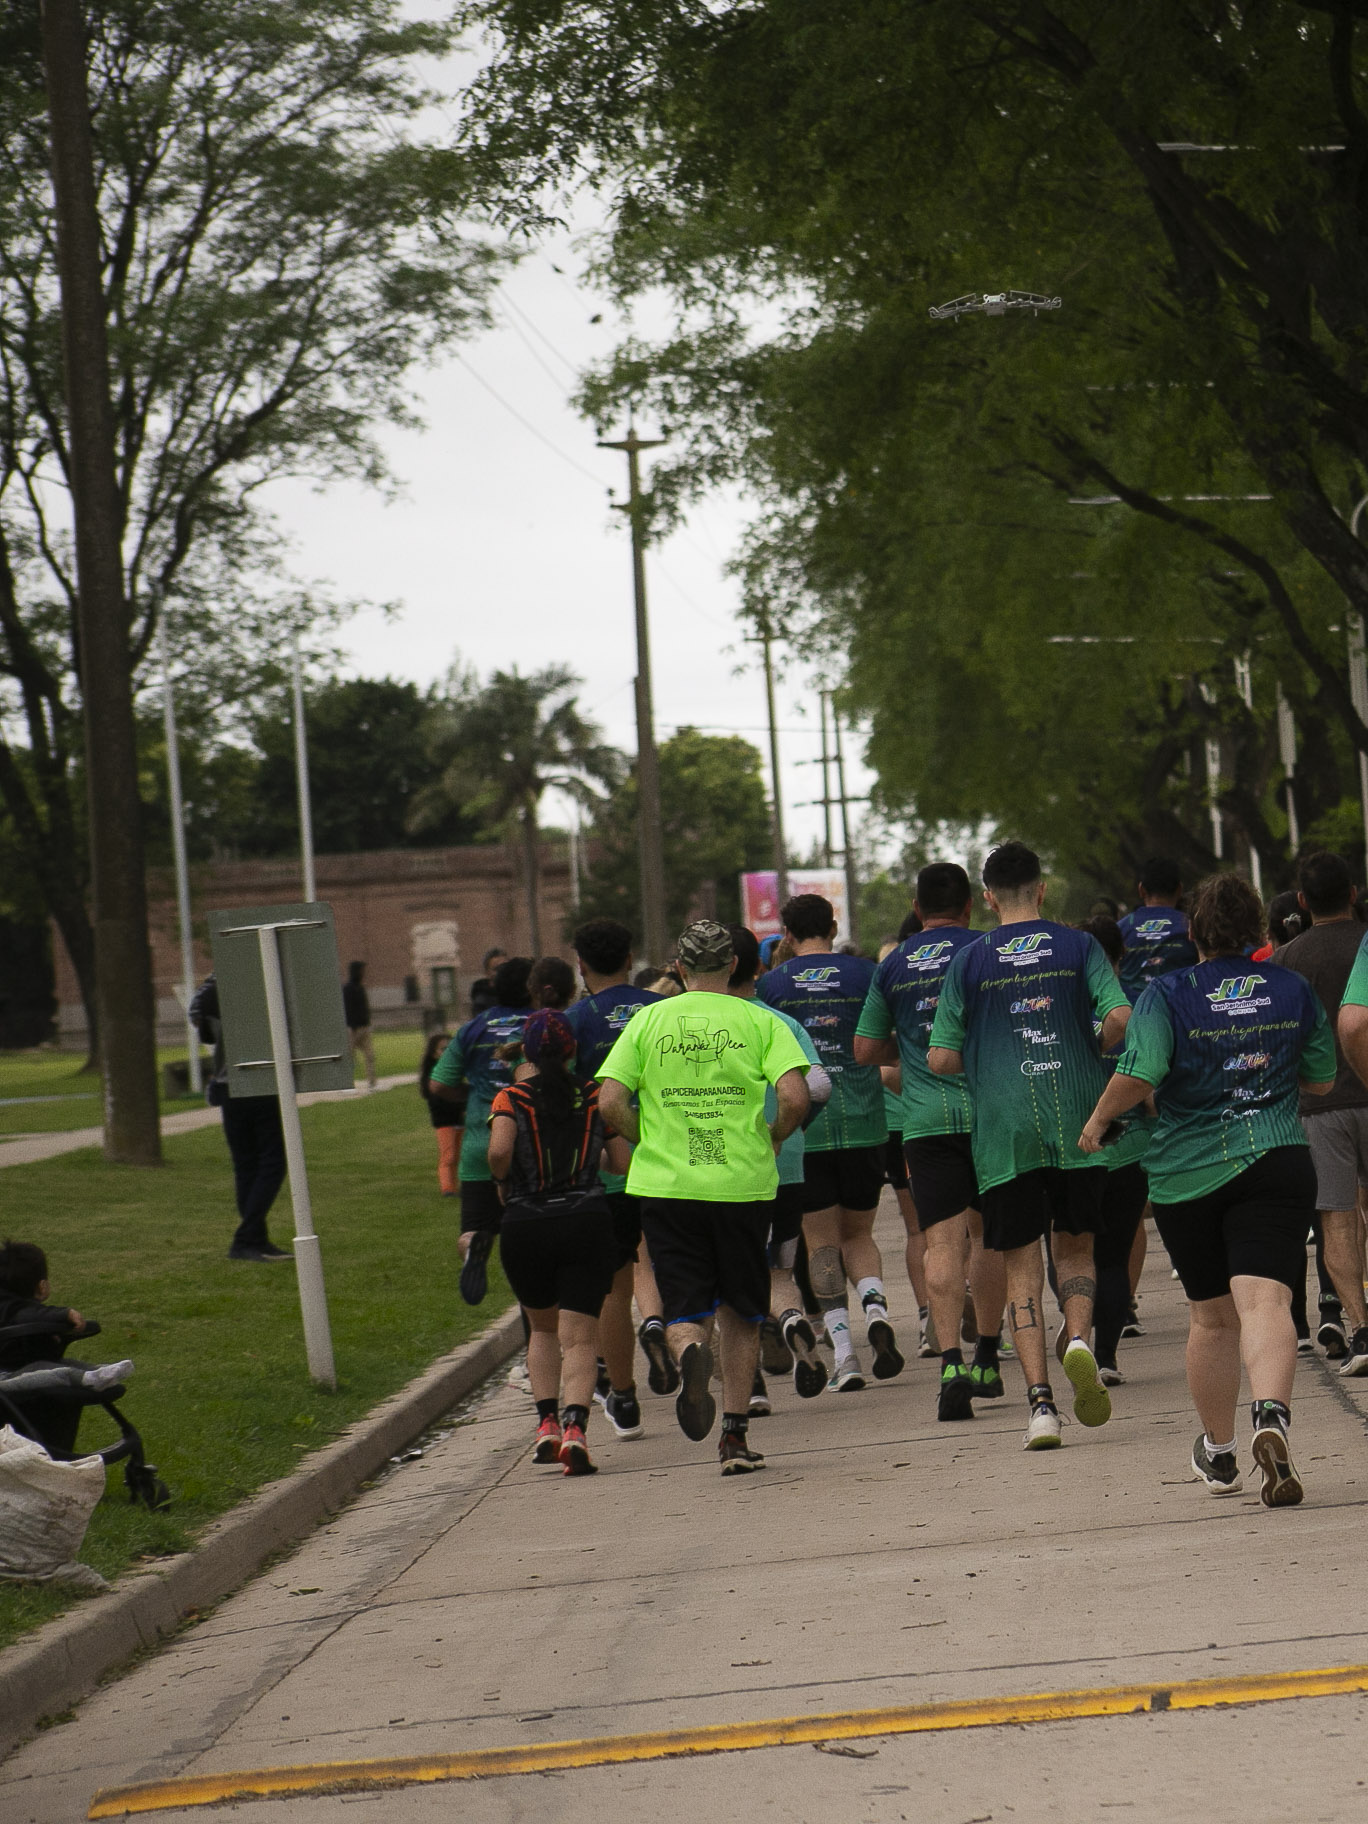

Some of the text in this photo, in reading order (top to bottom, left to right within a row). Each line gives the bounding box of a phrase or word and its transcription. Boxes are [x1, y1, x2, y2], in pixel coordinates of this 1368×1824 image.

[1211, 1003, 1225, 1011] San
[1257, 997, 1271, 1005] Sud
[1023, 1030, 1042, 1039] Max
[713, 1029, 747, 1055] Deco
[1032, 1036, 1050, 1044] Run
[1021, 1060, 1062, 1076] CRONO
[1232, 1088, 1255, 1098] Max
[715, 1098, 745, 1107] Espacios
